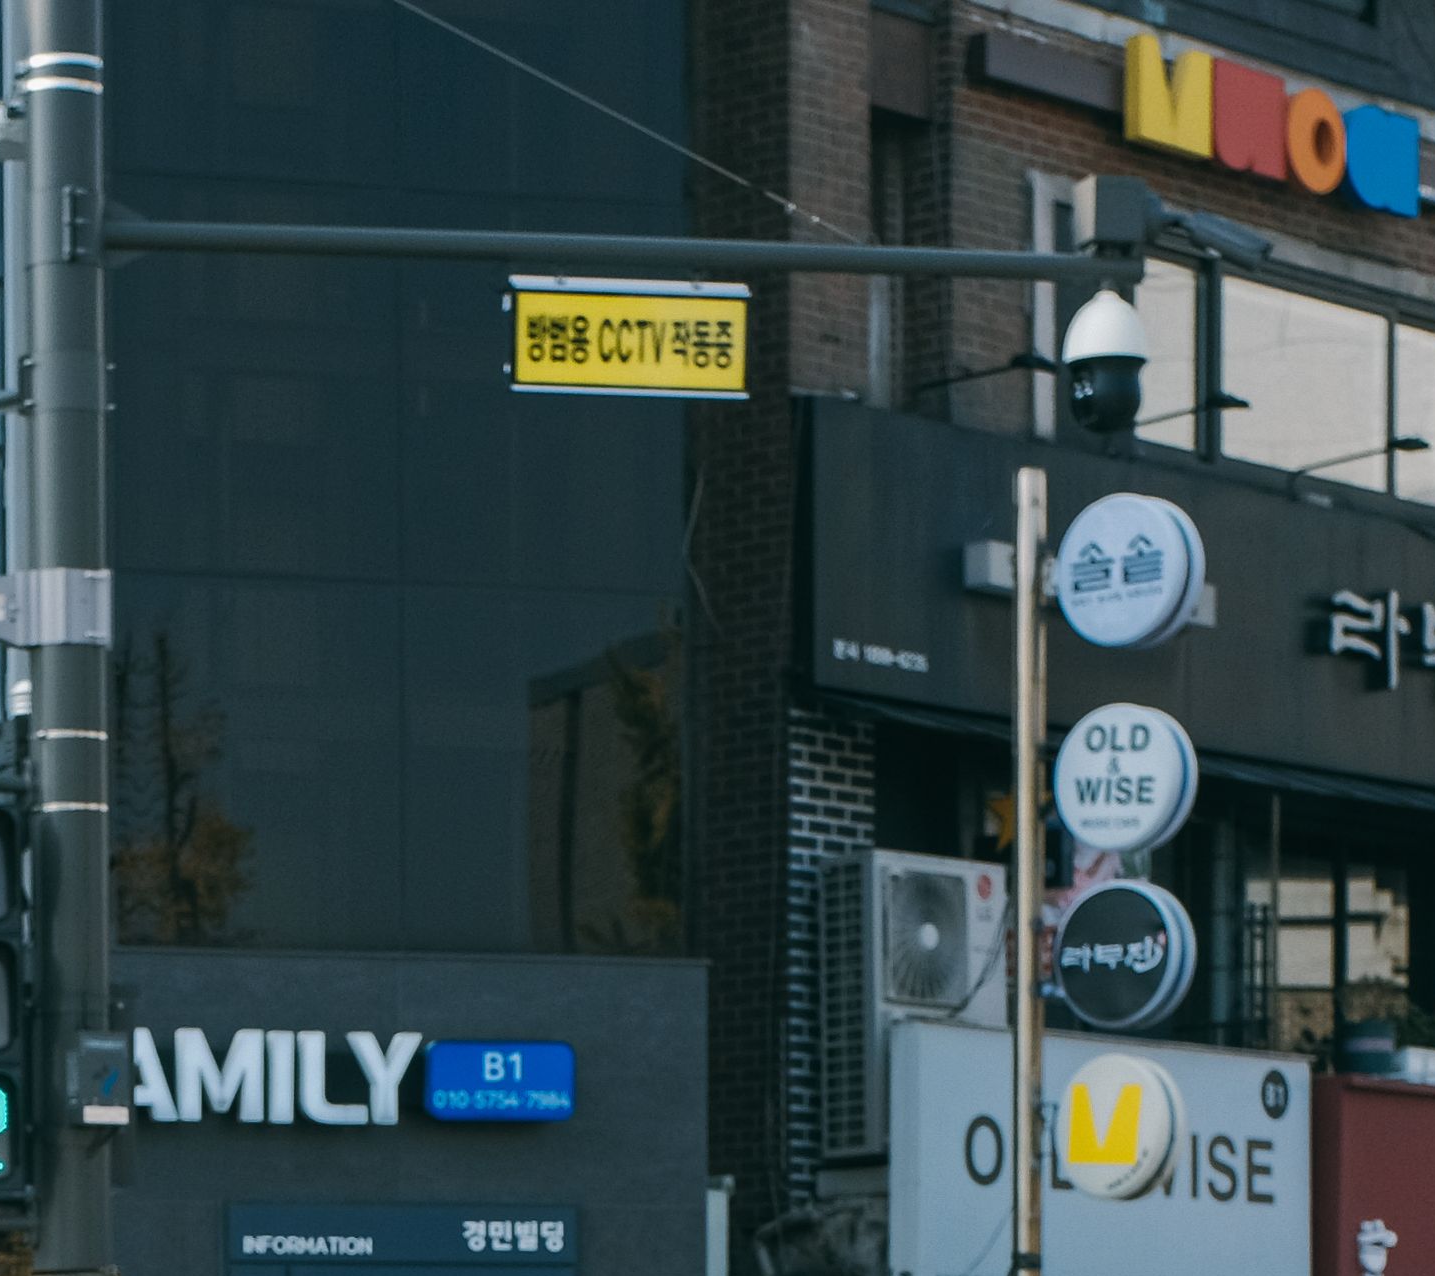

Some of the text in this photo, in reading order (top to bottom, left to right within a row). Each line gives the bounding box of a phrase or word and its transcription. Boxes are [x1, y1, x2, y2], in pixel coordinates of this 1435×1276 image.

[527, 313, 733, 370] 방범용 CCTV 작동중
[1085, 725, 1151, 753] OLD
[1074, 776, 1156, 806] WISE
[1060, 934, 1165, 974] 라무진
[133, 1026, 423, 1125] AMILY
[483, 1051, 523, 1083] B1
[1163, 1133, 1275, 1205] ISE
[242, 1235, 374, 1257] INFORMATION
[462, 1219, 565, 1253] 경민빌딩
